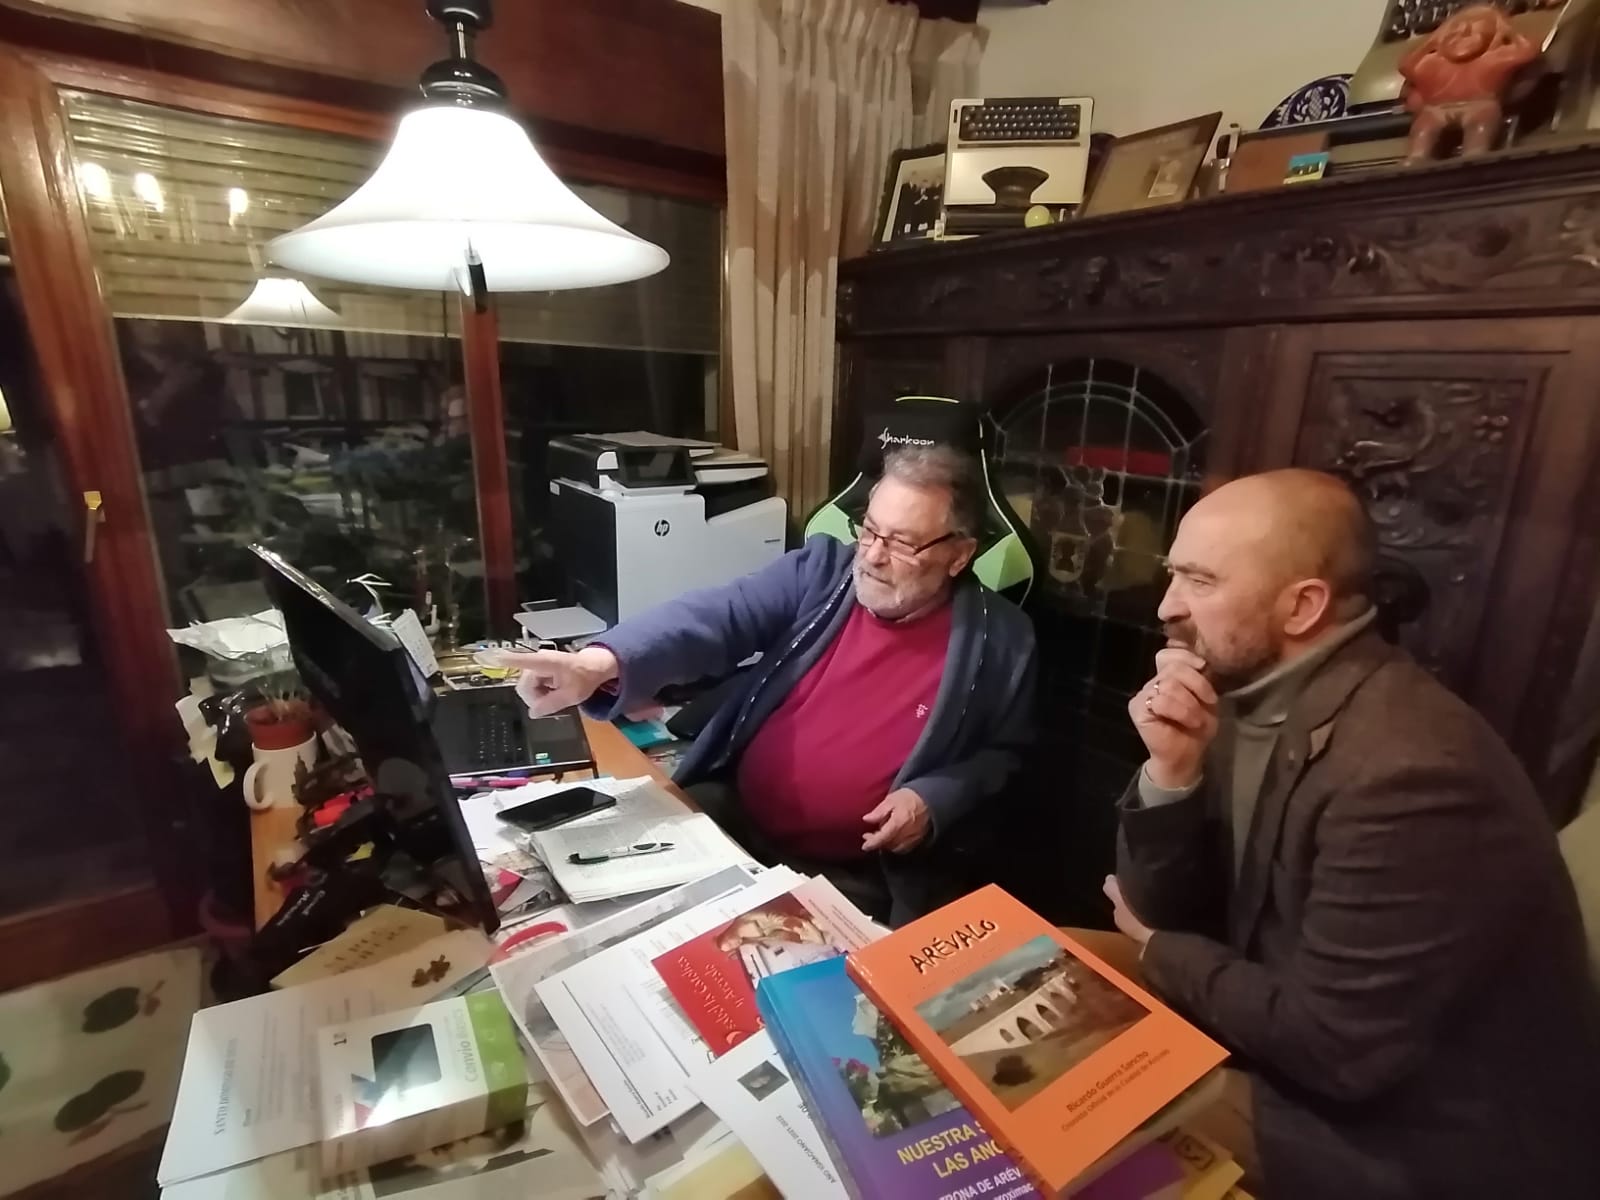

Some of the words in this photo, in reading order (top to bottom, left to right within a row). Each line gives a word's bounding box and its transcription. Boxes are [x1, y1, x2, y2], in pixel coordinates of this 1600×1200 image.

[877, 426, 936, 450] Sharkoon
[654, 519, 670, 537] hp
[909, 919, 996, 974] ARÉVALO
[456, 1040, 478, 1083] Canvio
[1067, 1089, 1096, 1112] Ricardo
[1095, 1069, 1122, 1090] Guerra
[1120, 1050, 1148, 1071] Sancho
[896, 1123, 977, 1165] NUESTRA
[932, 1152, 970, 1178] LAS
[976, 1178, 994, 1193] DE
[993, 1167, 1024, 1187] ARÉV
